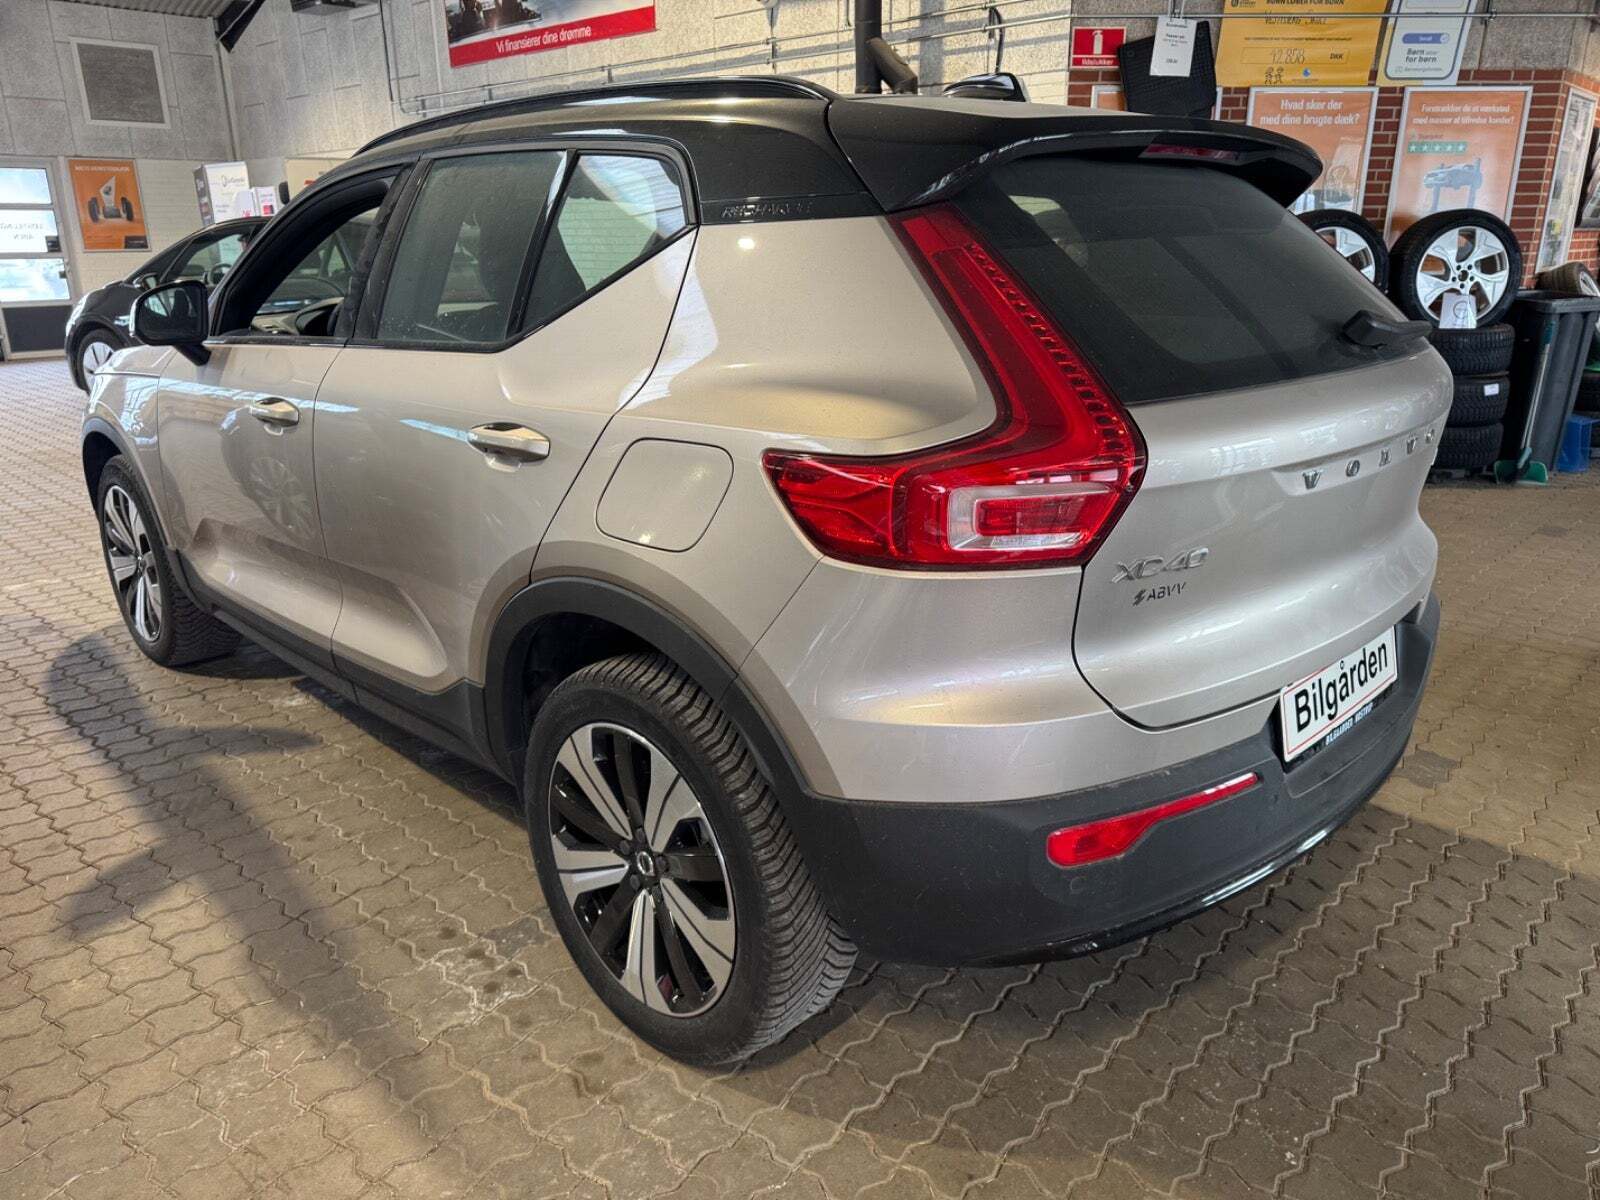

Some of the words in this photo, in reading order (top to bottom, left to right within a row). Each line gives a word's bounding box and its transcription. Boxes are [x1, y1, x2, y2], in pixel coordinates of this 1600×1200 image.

[495, 40, 505, 53] Vi
[505, 36, 541, 52] finansierer
[542, 31, 559, 45] dine
[559, 25, 592, 42] drømme
[1405, 55, 1418, 63] for
[1418, 55, 1438, 63] børn
[1280, 99, 1305, 111] Hvad
[1327, 99, 1344, 111] der
[1260, 113, 1281, 125] med
[1281, 113, 1302, 125] dine
[1303, 114, 1333, 127] brugte
[1111, 547, 1209, 584] XC40
[1294, 642, 1388, 733] Bilgården
